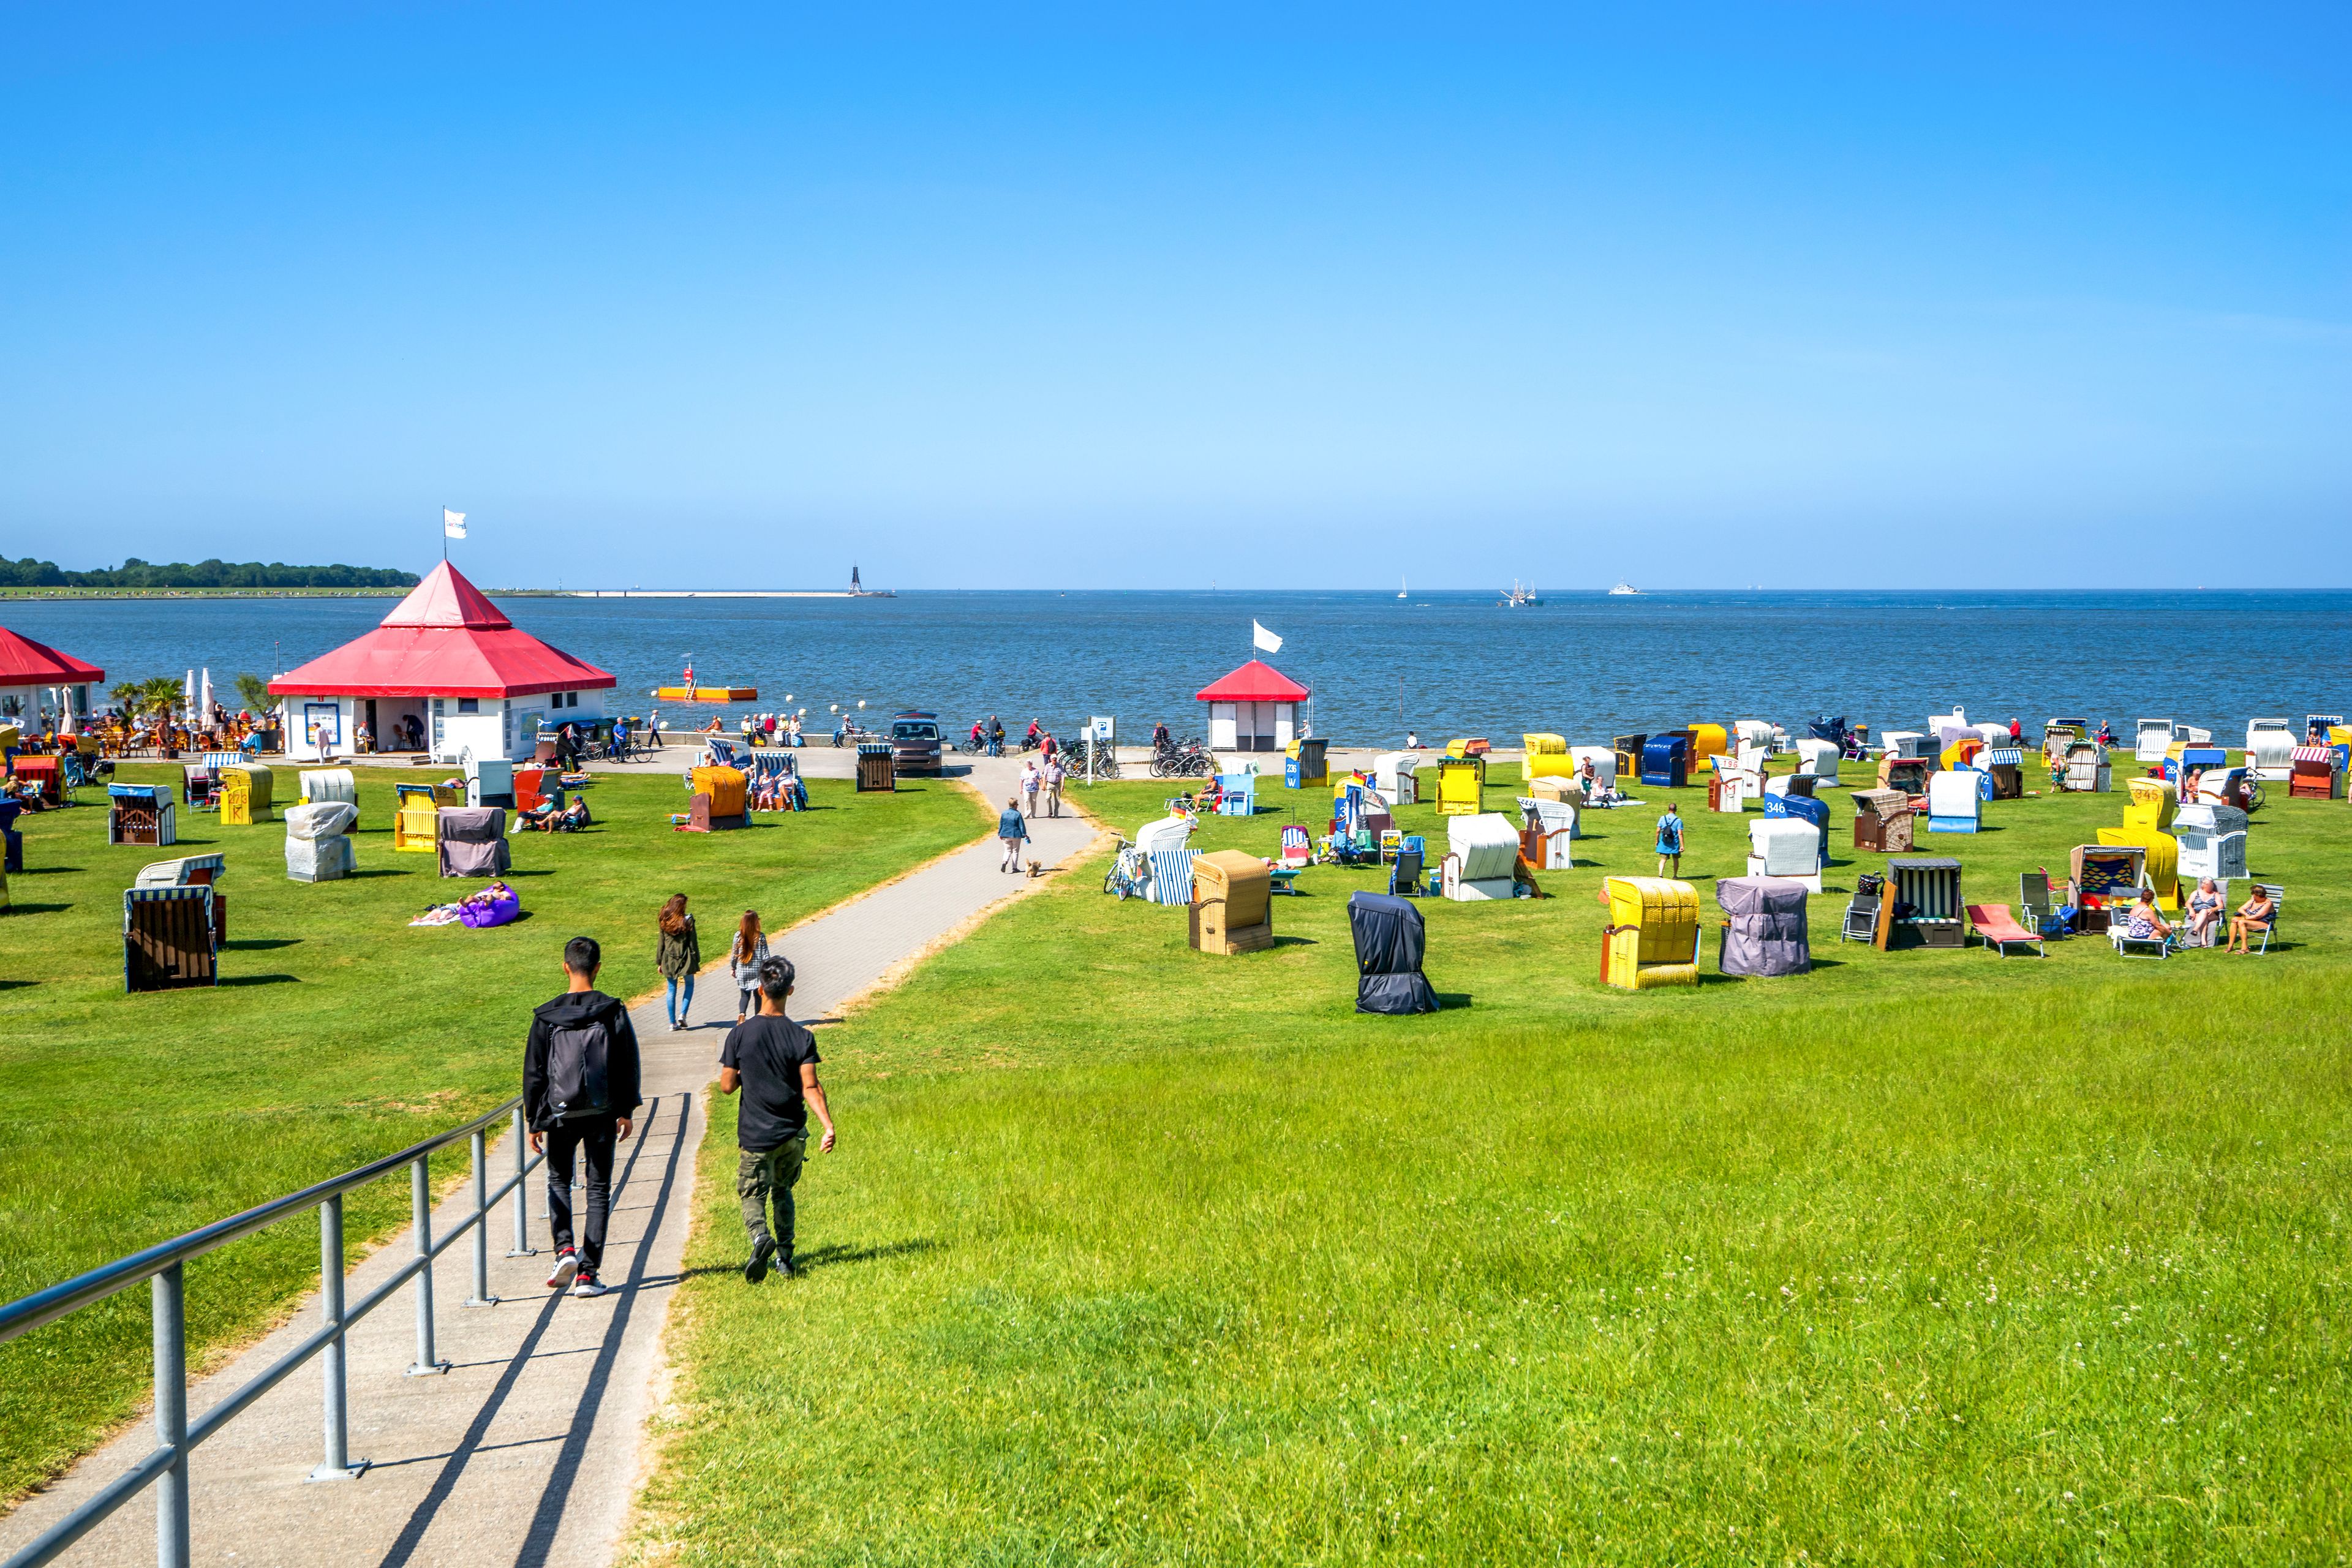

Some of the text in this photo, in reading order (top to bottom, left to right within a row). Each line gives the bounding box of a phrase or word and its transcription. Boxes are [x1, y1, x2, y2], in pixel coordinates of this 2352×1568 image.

[1287, 764, 1297, 773] 236
[1287, 778, 1296, 787] W
[1724, 784, 1736, 794] M
[228, 794, 247, 804] 273
[2135, 789, 2158, 800] 345
[1766, 802, 1785, 813] 346
[233, 808, 241, 819] K
